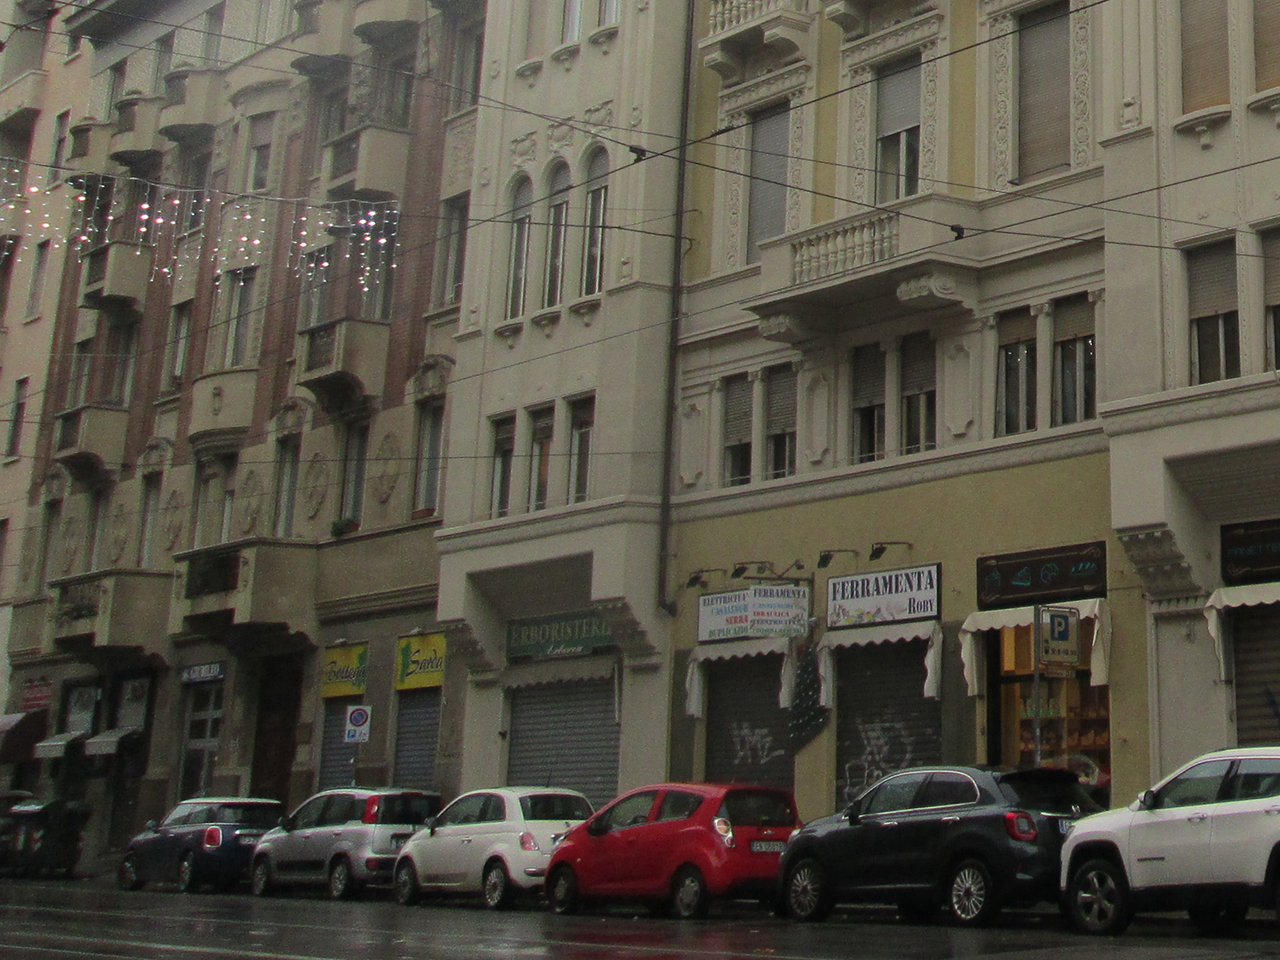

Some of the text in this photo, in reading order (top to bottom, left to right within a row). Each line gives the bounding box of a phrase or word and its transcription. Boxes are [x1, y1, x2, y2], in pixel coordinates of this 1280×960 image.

[753, 588, 807, 599] FERRAMENTA
[832, 569, 935, 602] FERRAMENTA
[1053, 616, 1066, 639] P
